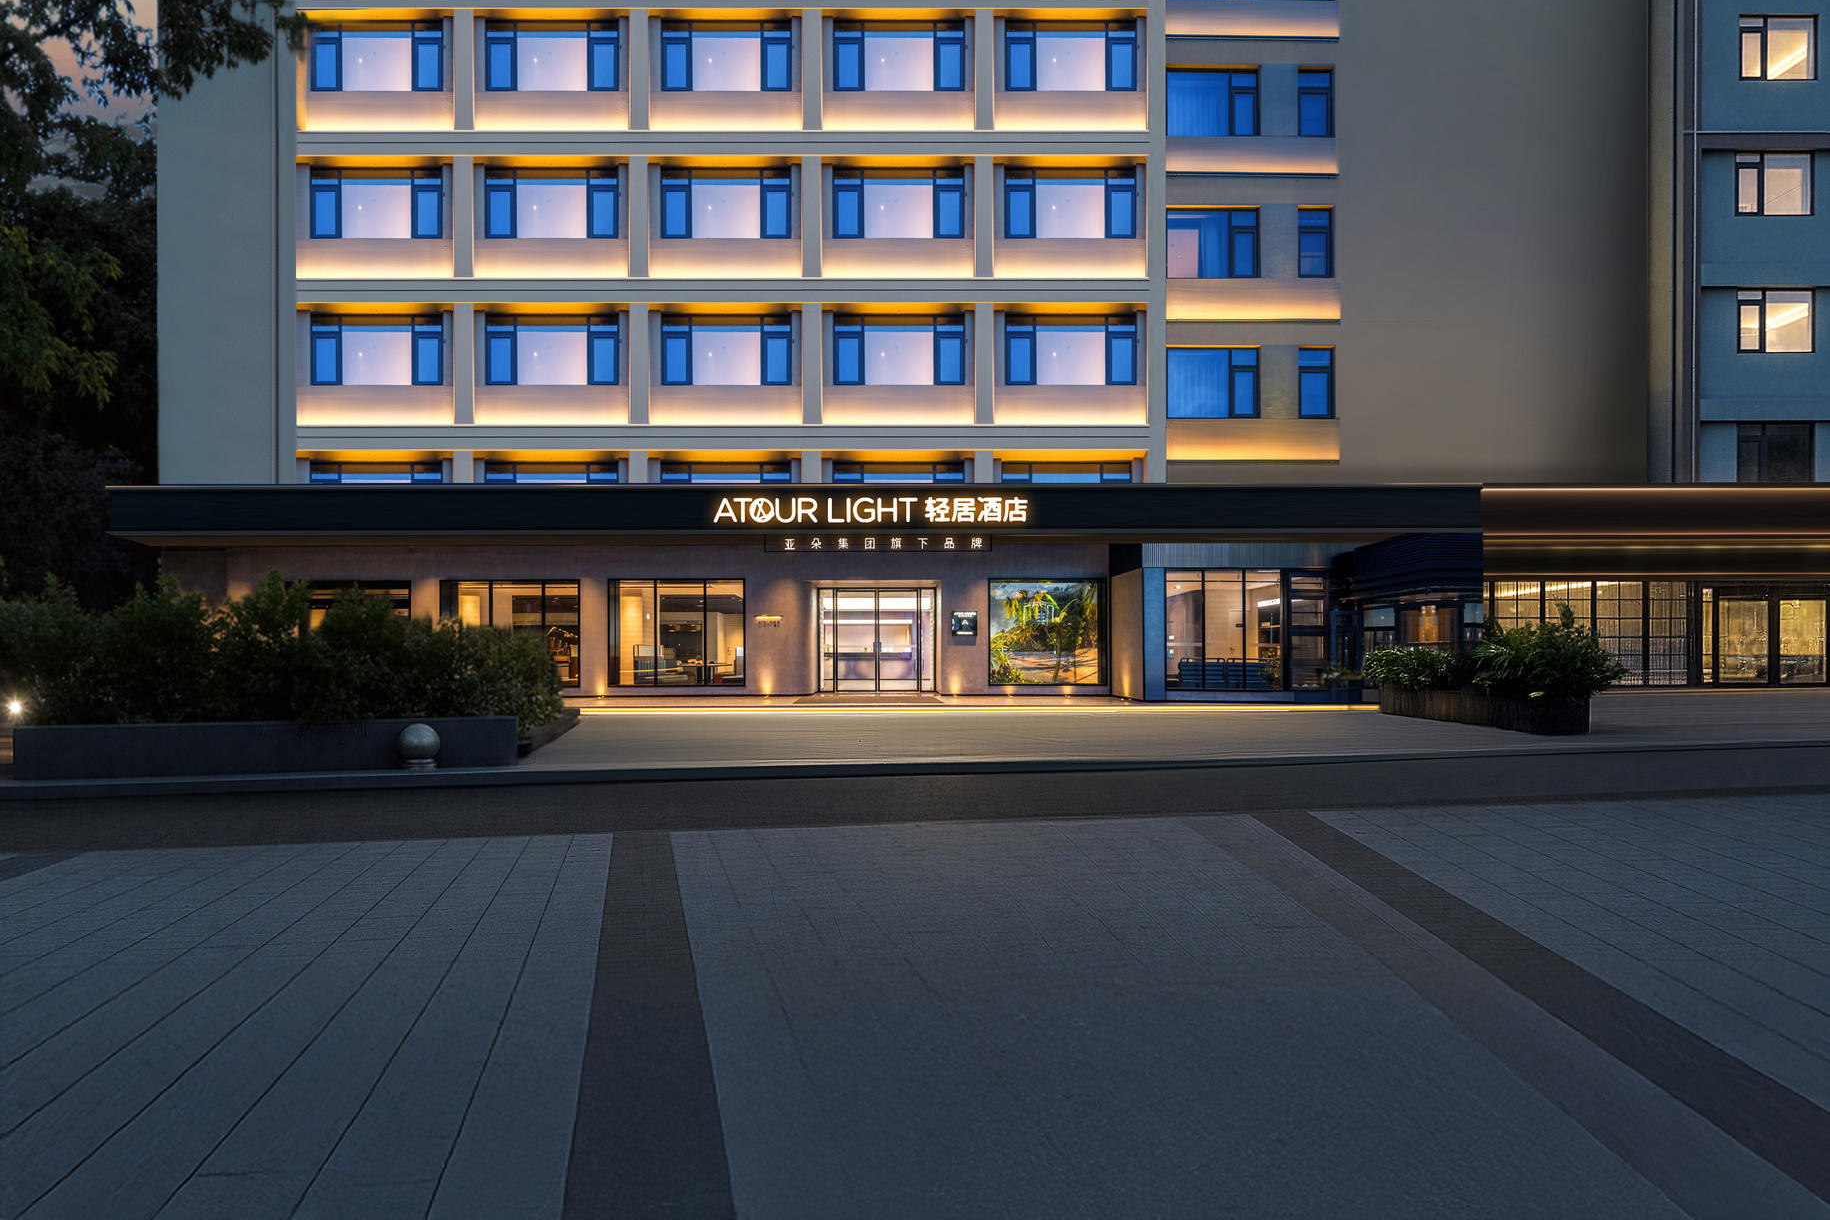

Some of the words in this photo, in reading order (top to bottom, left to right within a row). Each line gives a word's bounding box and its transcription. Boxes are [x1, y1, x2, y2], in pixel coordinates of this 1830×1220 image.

[713, 497, 818, 523] ATOUR
[827, 497, 918, 523] LIGHT
[924, 496, 1028, 523] 轻居酒店
[784, 537, 983, 551] 亚朵集团旗下品牌
